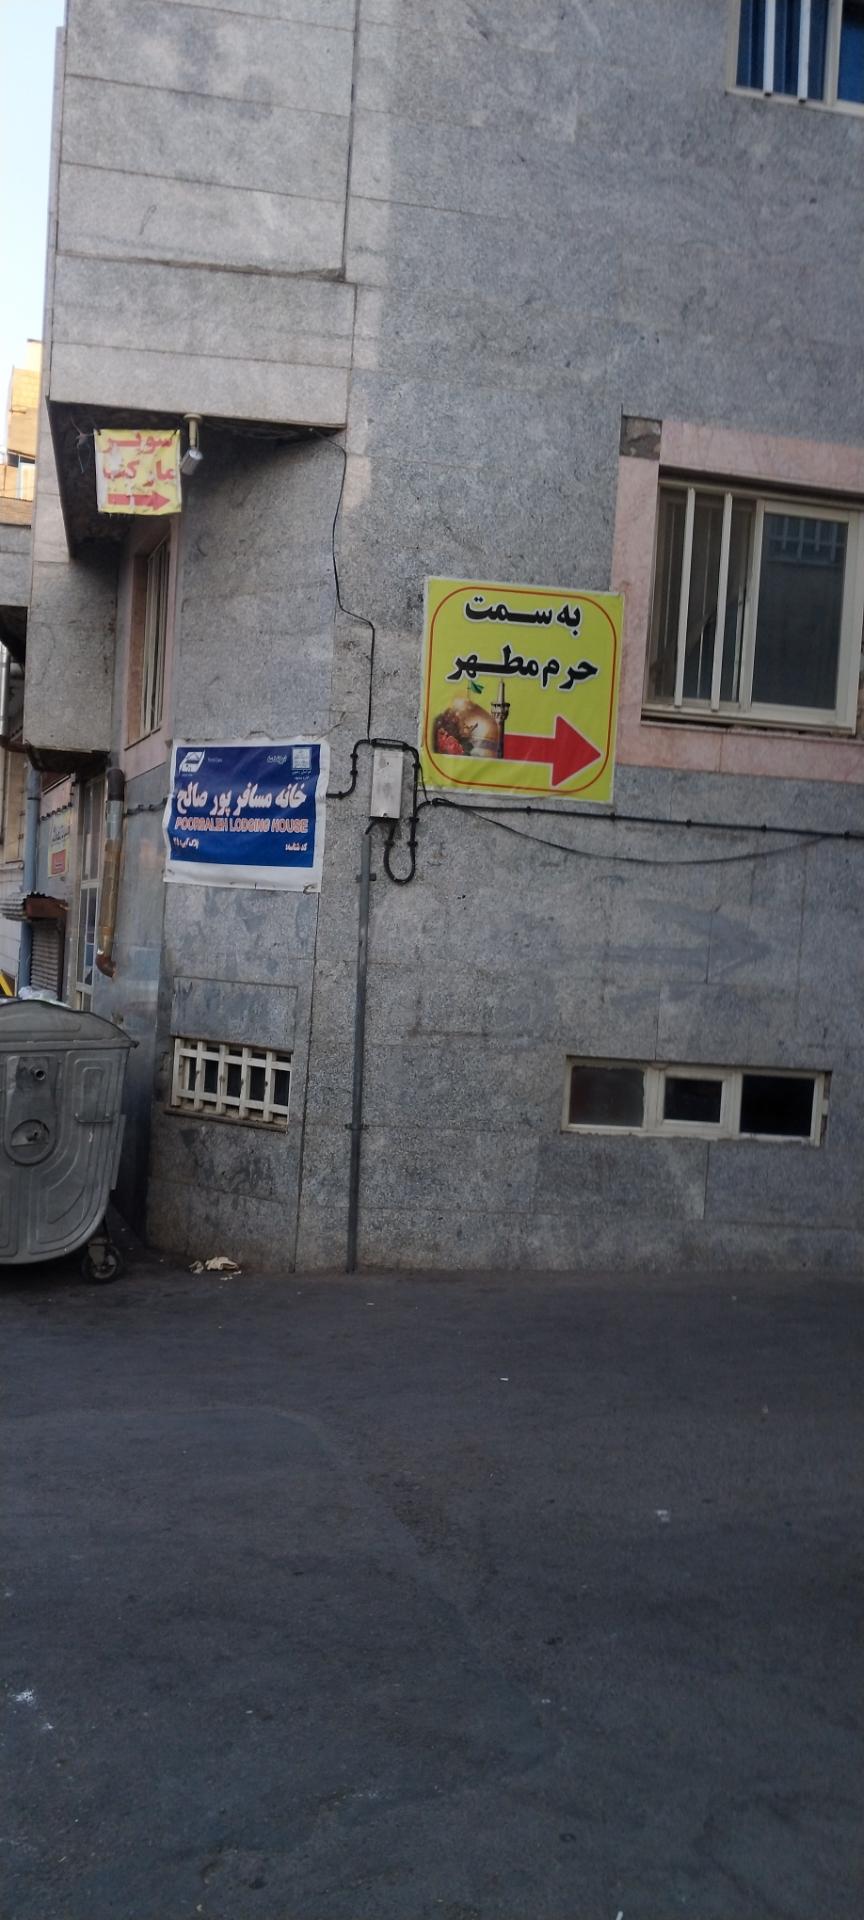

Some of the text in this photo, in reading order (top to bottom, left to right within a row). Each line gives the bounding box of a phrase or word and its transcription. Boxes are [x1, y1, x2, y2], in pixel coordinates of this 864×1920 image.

[465, 596, 581, 636] به سمت
[446, 644, 599, 690] حرم مطهر
[176, 781, 307, 817] خانه مسافر پور صالح
[229, 817, 271, 833] LODGING
[270, 818, 309, 834] HOUSE
